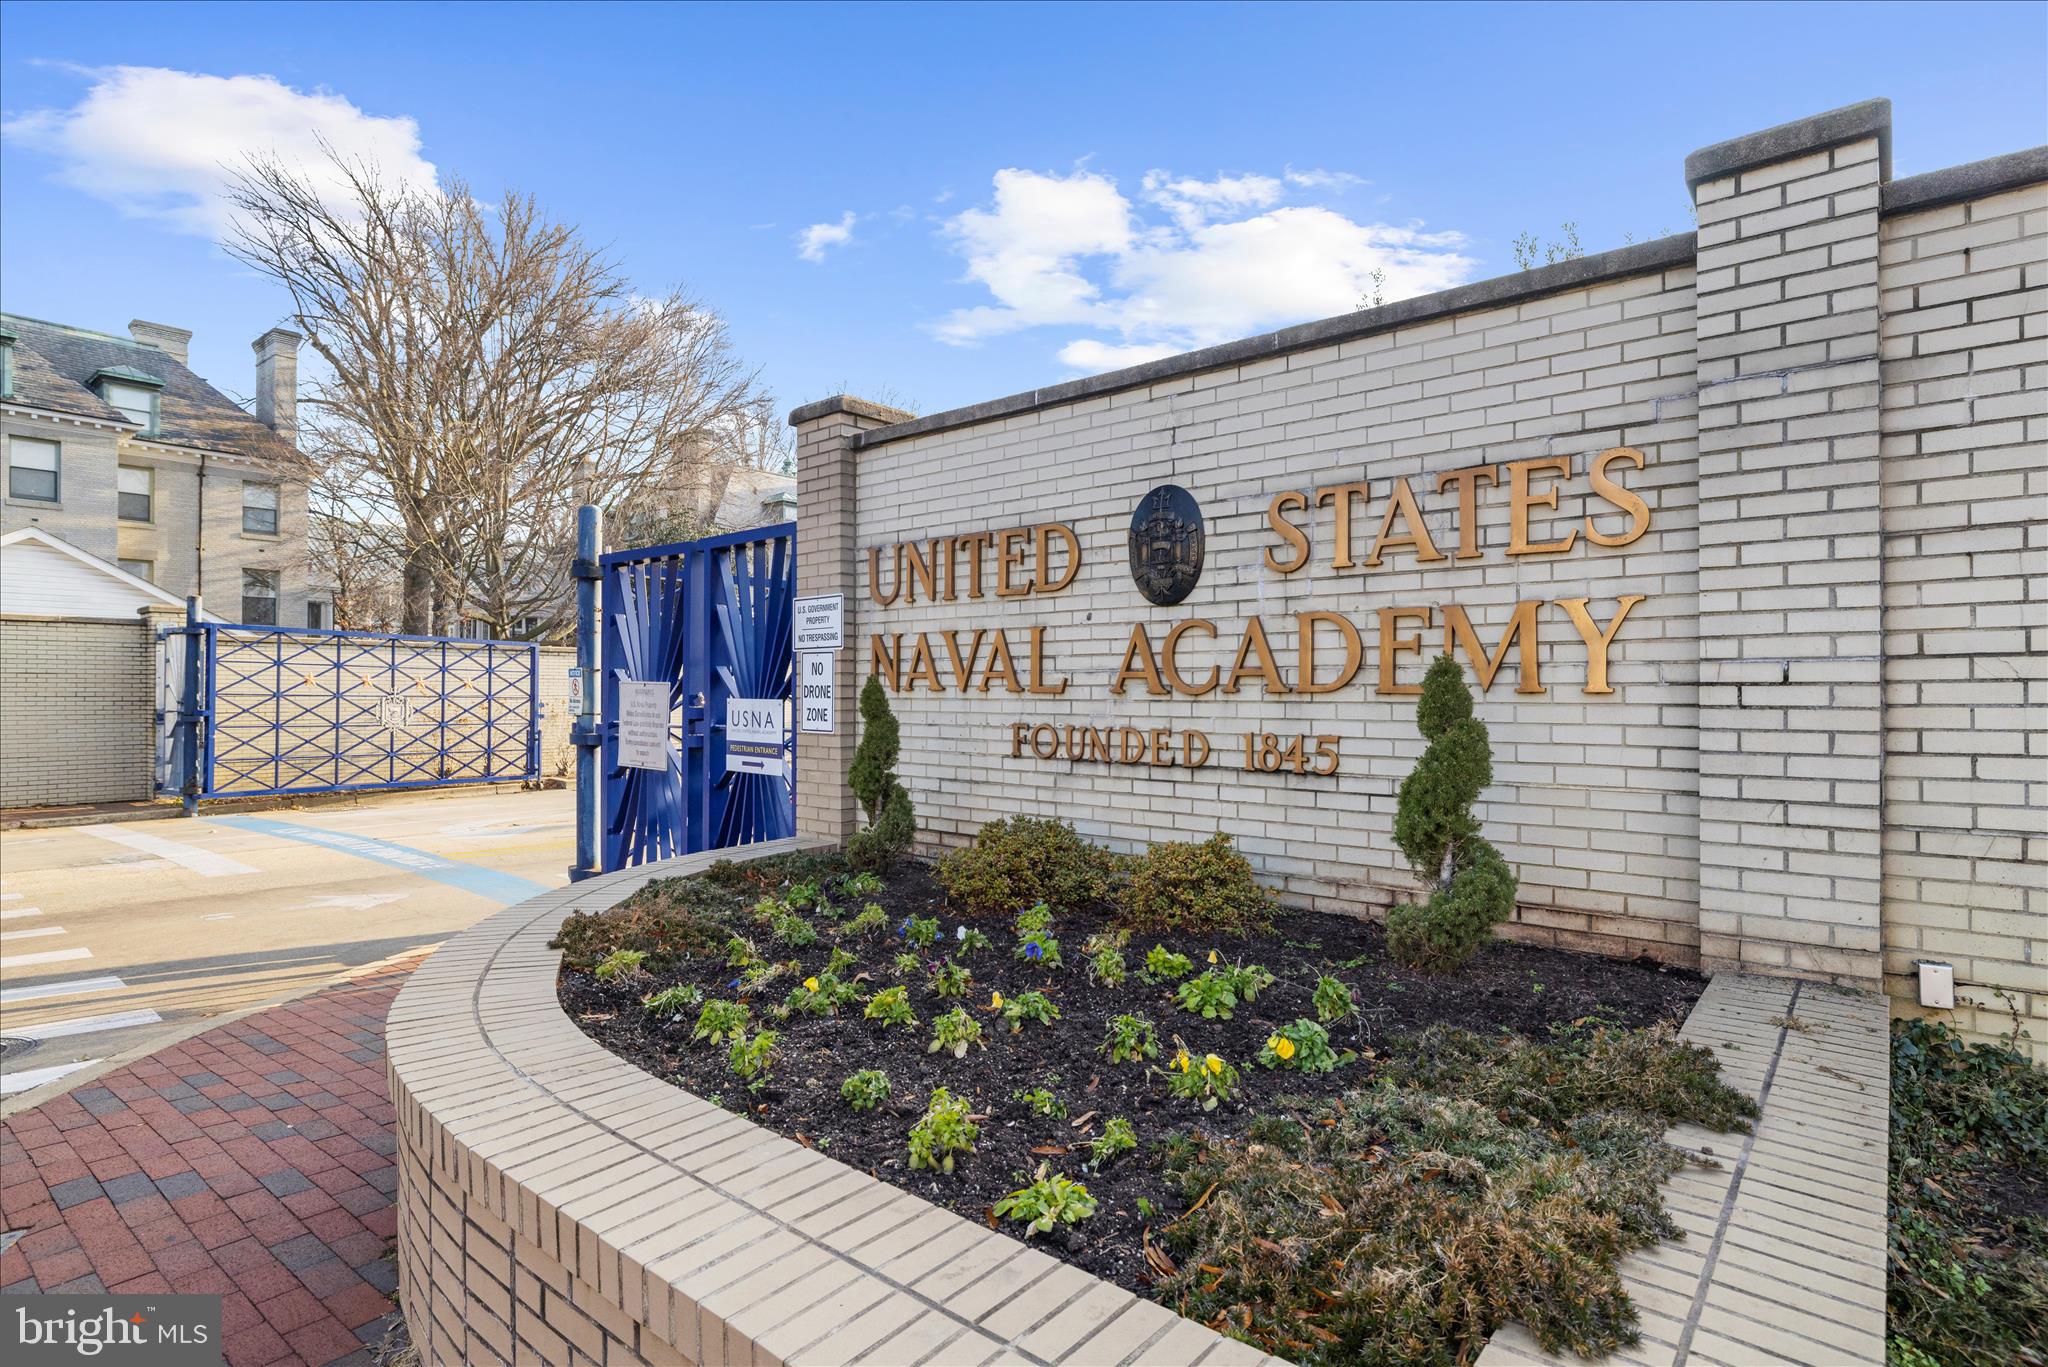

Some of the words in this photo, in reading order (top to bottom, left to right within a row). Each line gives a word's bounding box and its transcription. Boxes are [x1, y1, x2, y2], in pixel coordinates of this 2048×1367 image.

[867, 522, 1081, 606] UNITED
[1264, 446, 1651, 574] STATES
[798, 604, 806, 614] U.S.
[808, 602, 839, 613] GOVERNMENT
[806, 616, 830, 625] PROPERTY
[798, 635, 806, 643] NO
[806, 632, 838, 642] TRESPASSING
[871, 626, 1069, 694] NAVAL
[1111, 594, 1646, 696] ACADEMY
[812, 662, 824, 676] NO
[804, 685, 831, 698] DRONE
[732, 710, 774, 728] USNA
[807, 708, 828, 722] ZONE
[730, 744, 754, 752] PEDESTRIAN
[754, 746, 778, 754] ENTRANCE
[1012, 722, 1211, 768] FOUNDED
[1243, 732, 1341, 776] 1845
